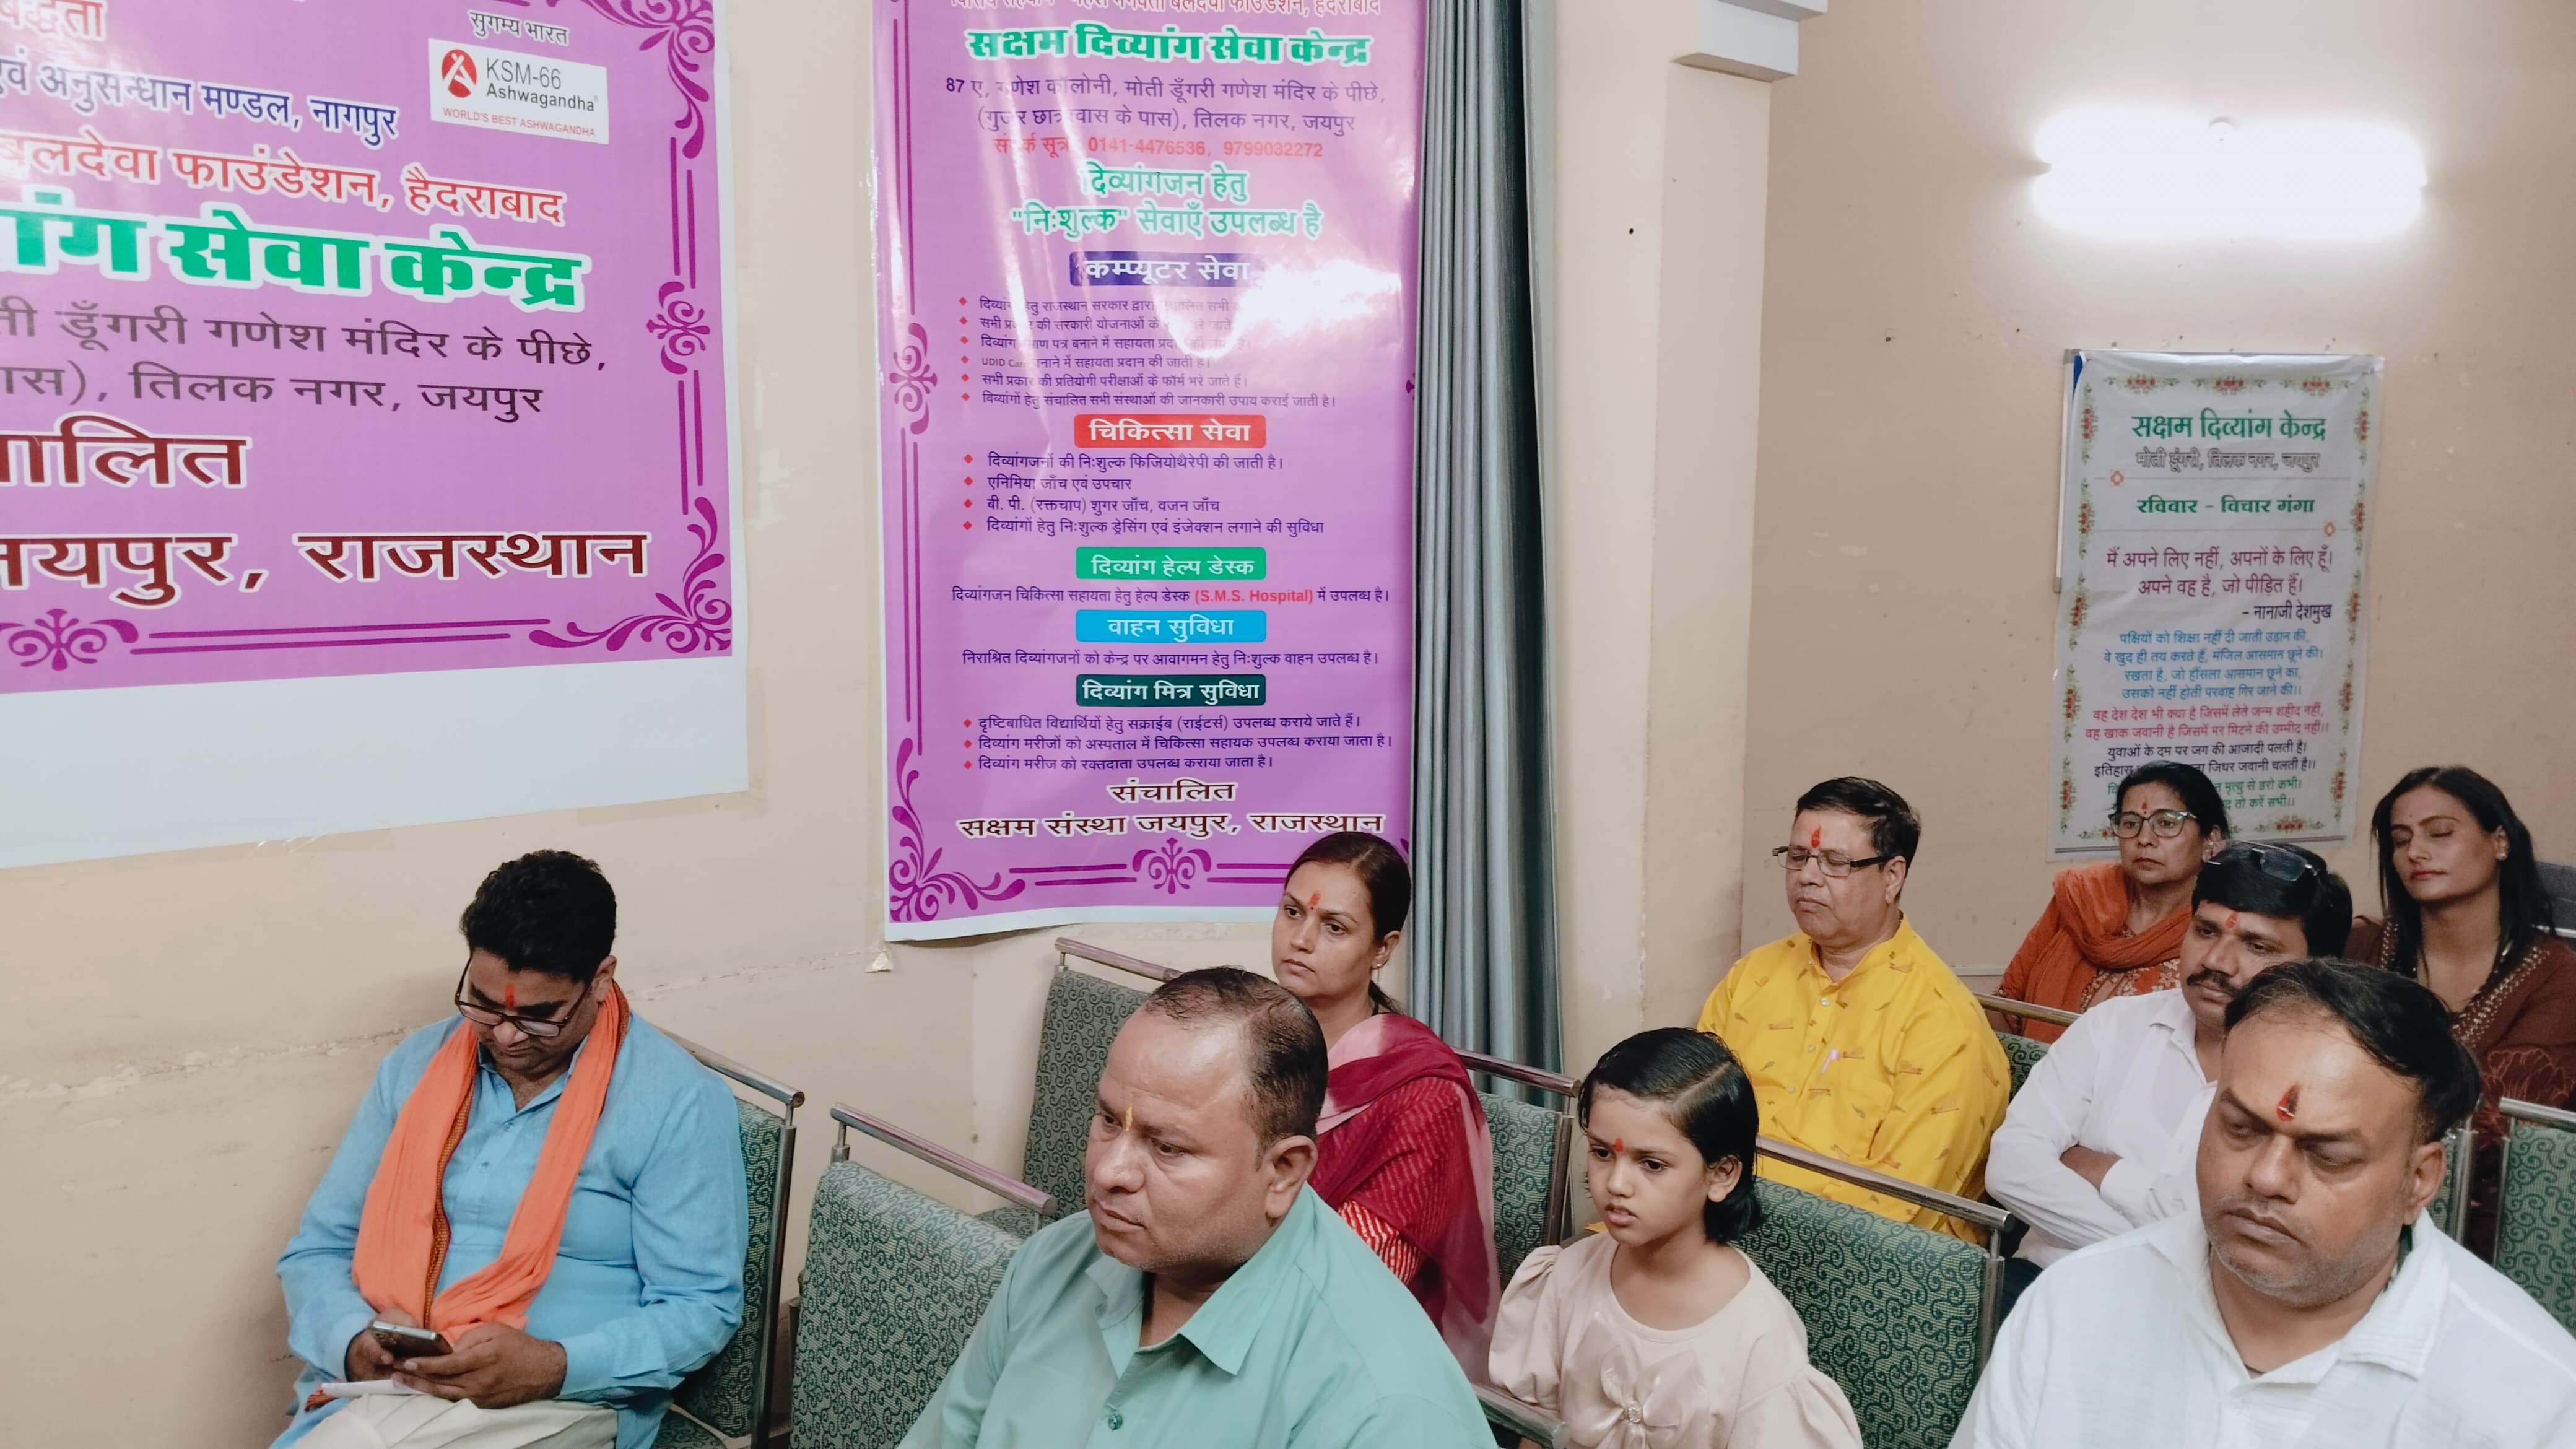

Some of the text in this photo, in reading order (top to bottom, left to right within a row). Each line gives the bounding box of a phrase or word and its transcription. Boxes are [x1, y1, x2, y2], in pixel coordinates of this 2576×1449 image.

[469, 11, 568, 45] सुगम्य भारत
[968, 22, 1371, 64] सक्षम दिव्यांग सेवा केन्द्र
[486, 57, 562, 90] KSM-66
[486, 82, 594, 111] Ashwagandha
[946, 77, 965, 94] 87
[1125, 76, 1164, 97] मोती
[1221, 79, 1268, 99] गणेश
[1272, 79, 1316, 100] मंदिर
[1321, 80, 1339, 101] के
[1344, 81, 1385, 103] पीछे,
[201, 85, 300, 128] मण्डल,
[311, 99, 396, 146] नागपुर
[442, 107, 596, 137] WORLD'S BEST ASHWAGANDHA
[1115, 105, 1133, 125] के
[1193, 108, 1247, 128] तिलक
[1251, 114, 1296, 131] नगर,
[1302, 115, 1356, 137] जयपुर
[1223, 141, 1323, 157] 9799032272
[405, 166, 562, 223] हैदराबाद
[1211, 163, 1248, 202] हेतु
[1208, 211, 1298, 233] उपलब्ध
[1302, 202, 1322, 238] है
[165, 209, 370, 289] सेवा
[384, 230, 583, 306] केन्द्र
[1084, 255, 1251, 284] कम्प्यूटर सेवा
[204, 311, 326, 352] गणेश
[342, 318, 450, 359] मंदिर
[463, 326, 503, 361] के
[516, 329, 606, 372] पीछे,
[981, 357, 1006, 367] UDID
[128, 360, 544, 424] तिलक नगर, जयपुर
[1043, 392, 1087, 406] संचालित
[1178, 392, 1225, 406] जानकारी
[1088, 418, 1251, 441] चिकित्सा सेवा
[2131, 407, 2327, 441] सक्षम दिव्यांग केन्द्र
[1058, 453, 1074, 469] की
[1213, 453, 1229, 469] की
[1233, 453, 1264, 469] जाती
[2136, 494, 2315, 513] रविवार विचार गंगा
[298, 531, 647, 579] राजस्थान
[1090, 554, 1255, 577] दिव्यांग हेल्प डेस्क
[2107, 546, 2121, 568] मैं
[2123, 545, 2159, 567] अपने
[2163, 546, 2190, 570] लिए
[2230, 545, 2269, 567] अपनों
[2272, 545, 2286, 566] के
[2290, 546, 2314, 568] लिए
[952, 585, 1371, 606] दिव्यांगजन चिकित्सा सहायता हेतु हेल्प डेस्क (S.M.S. Hospital) में उपलब्ध
[2138, 573, 2174, 595] अपने
[2176, 580, 2198, 598] वह
[2222, 573, 2241, 594] जो
[2253, 599, 2333, 624] नानाजी देशमुख
[1107, 614, 1234, 643] वाहन सुविधा
[1085, 650, 1100, 664] को
[1103, 651, 1129, 666] केन्द्र
[1133, 654, 1149, 665] पर
[1152, 653, 1208, 665] आवागमन
[1212, 651, 1230, 669] हेतु
[1284, 653, 1314, 666] वाहन
[1317, 652, 1359, 664] उपलब्ध
[1082, 679, 1260, 705] दिव्यांग मित्र सुविधा
[1105, 715, 1124, 734] हेतु
[1232, 717, 1276, 729] उपलब्ध
[1279, 714, 1312, 729] कराये
[1316, 713, 1341, 728] जाते
[2107, 742, 2142, 762] युवाओं
[2144, 743, 2155, 757] के
[2157, 746, 2172, 758] दम
[2175, 746, 2188, 756] पर
[2191, 745, 2209, 756] जग
[2211, 741, 2226, 755] की
[2267, 739, 2294, 754] पलती
[1110, 778, 1235, 801] संचालित
[959, 812, 1383, 838] सक्षम संस्था जयपुर, राजस्थान
